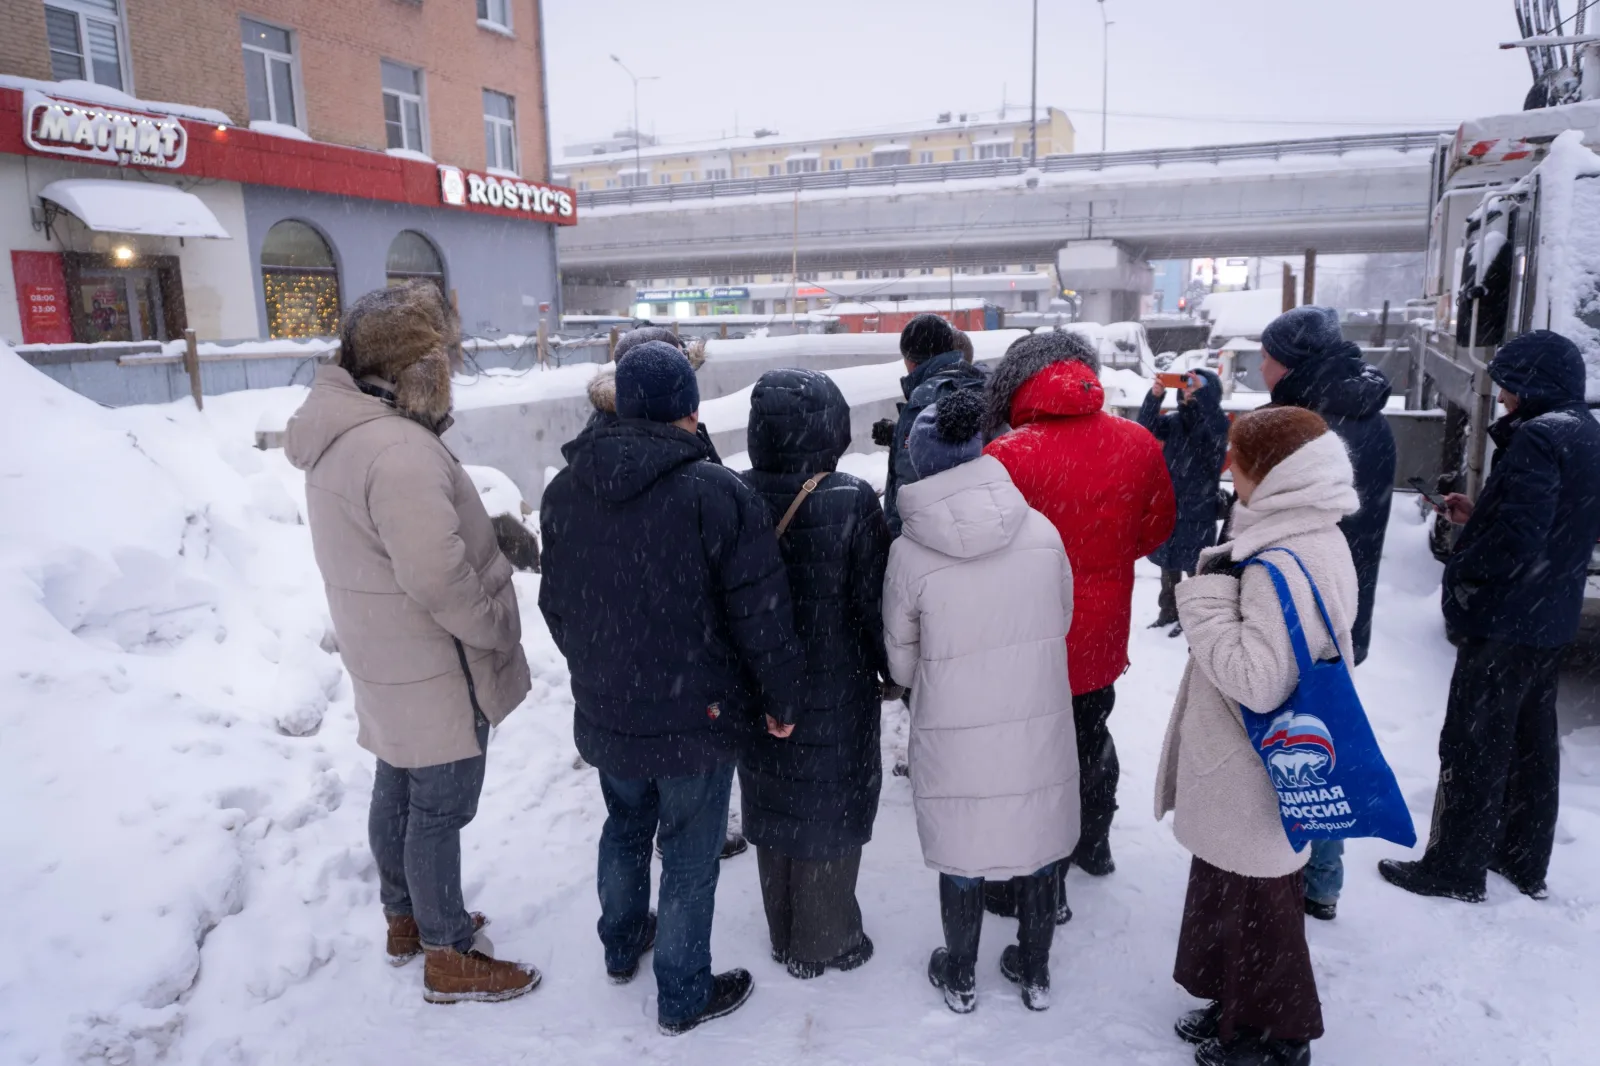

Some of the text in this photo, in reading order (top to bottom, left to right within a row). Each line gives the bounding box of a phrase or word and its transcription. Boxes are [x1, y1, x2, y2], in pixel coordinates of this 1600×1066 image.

[38, 113, 178, 156] МАГНИТ
[468, 175, 573, 216] ROSTIC'S
[30, 294, 55, 302] 08:00
[1281, 801, 1352, 818] РОССИЯ
